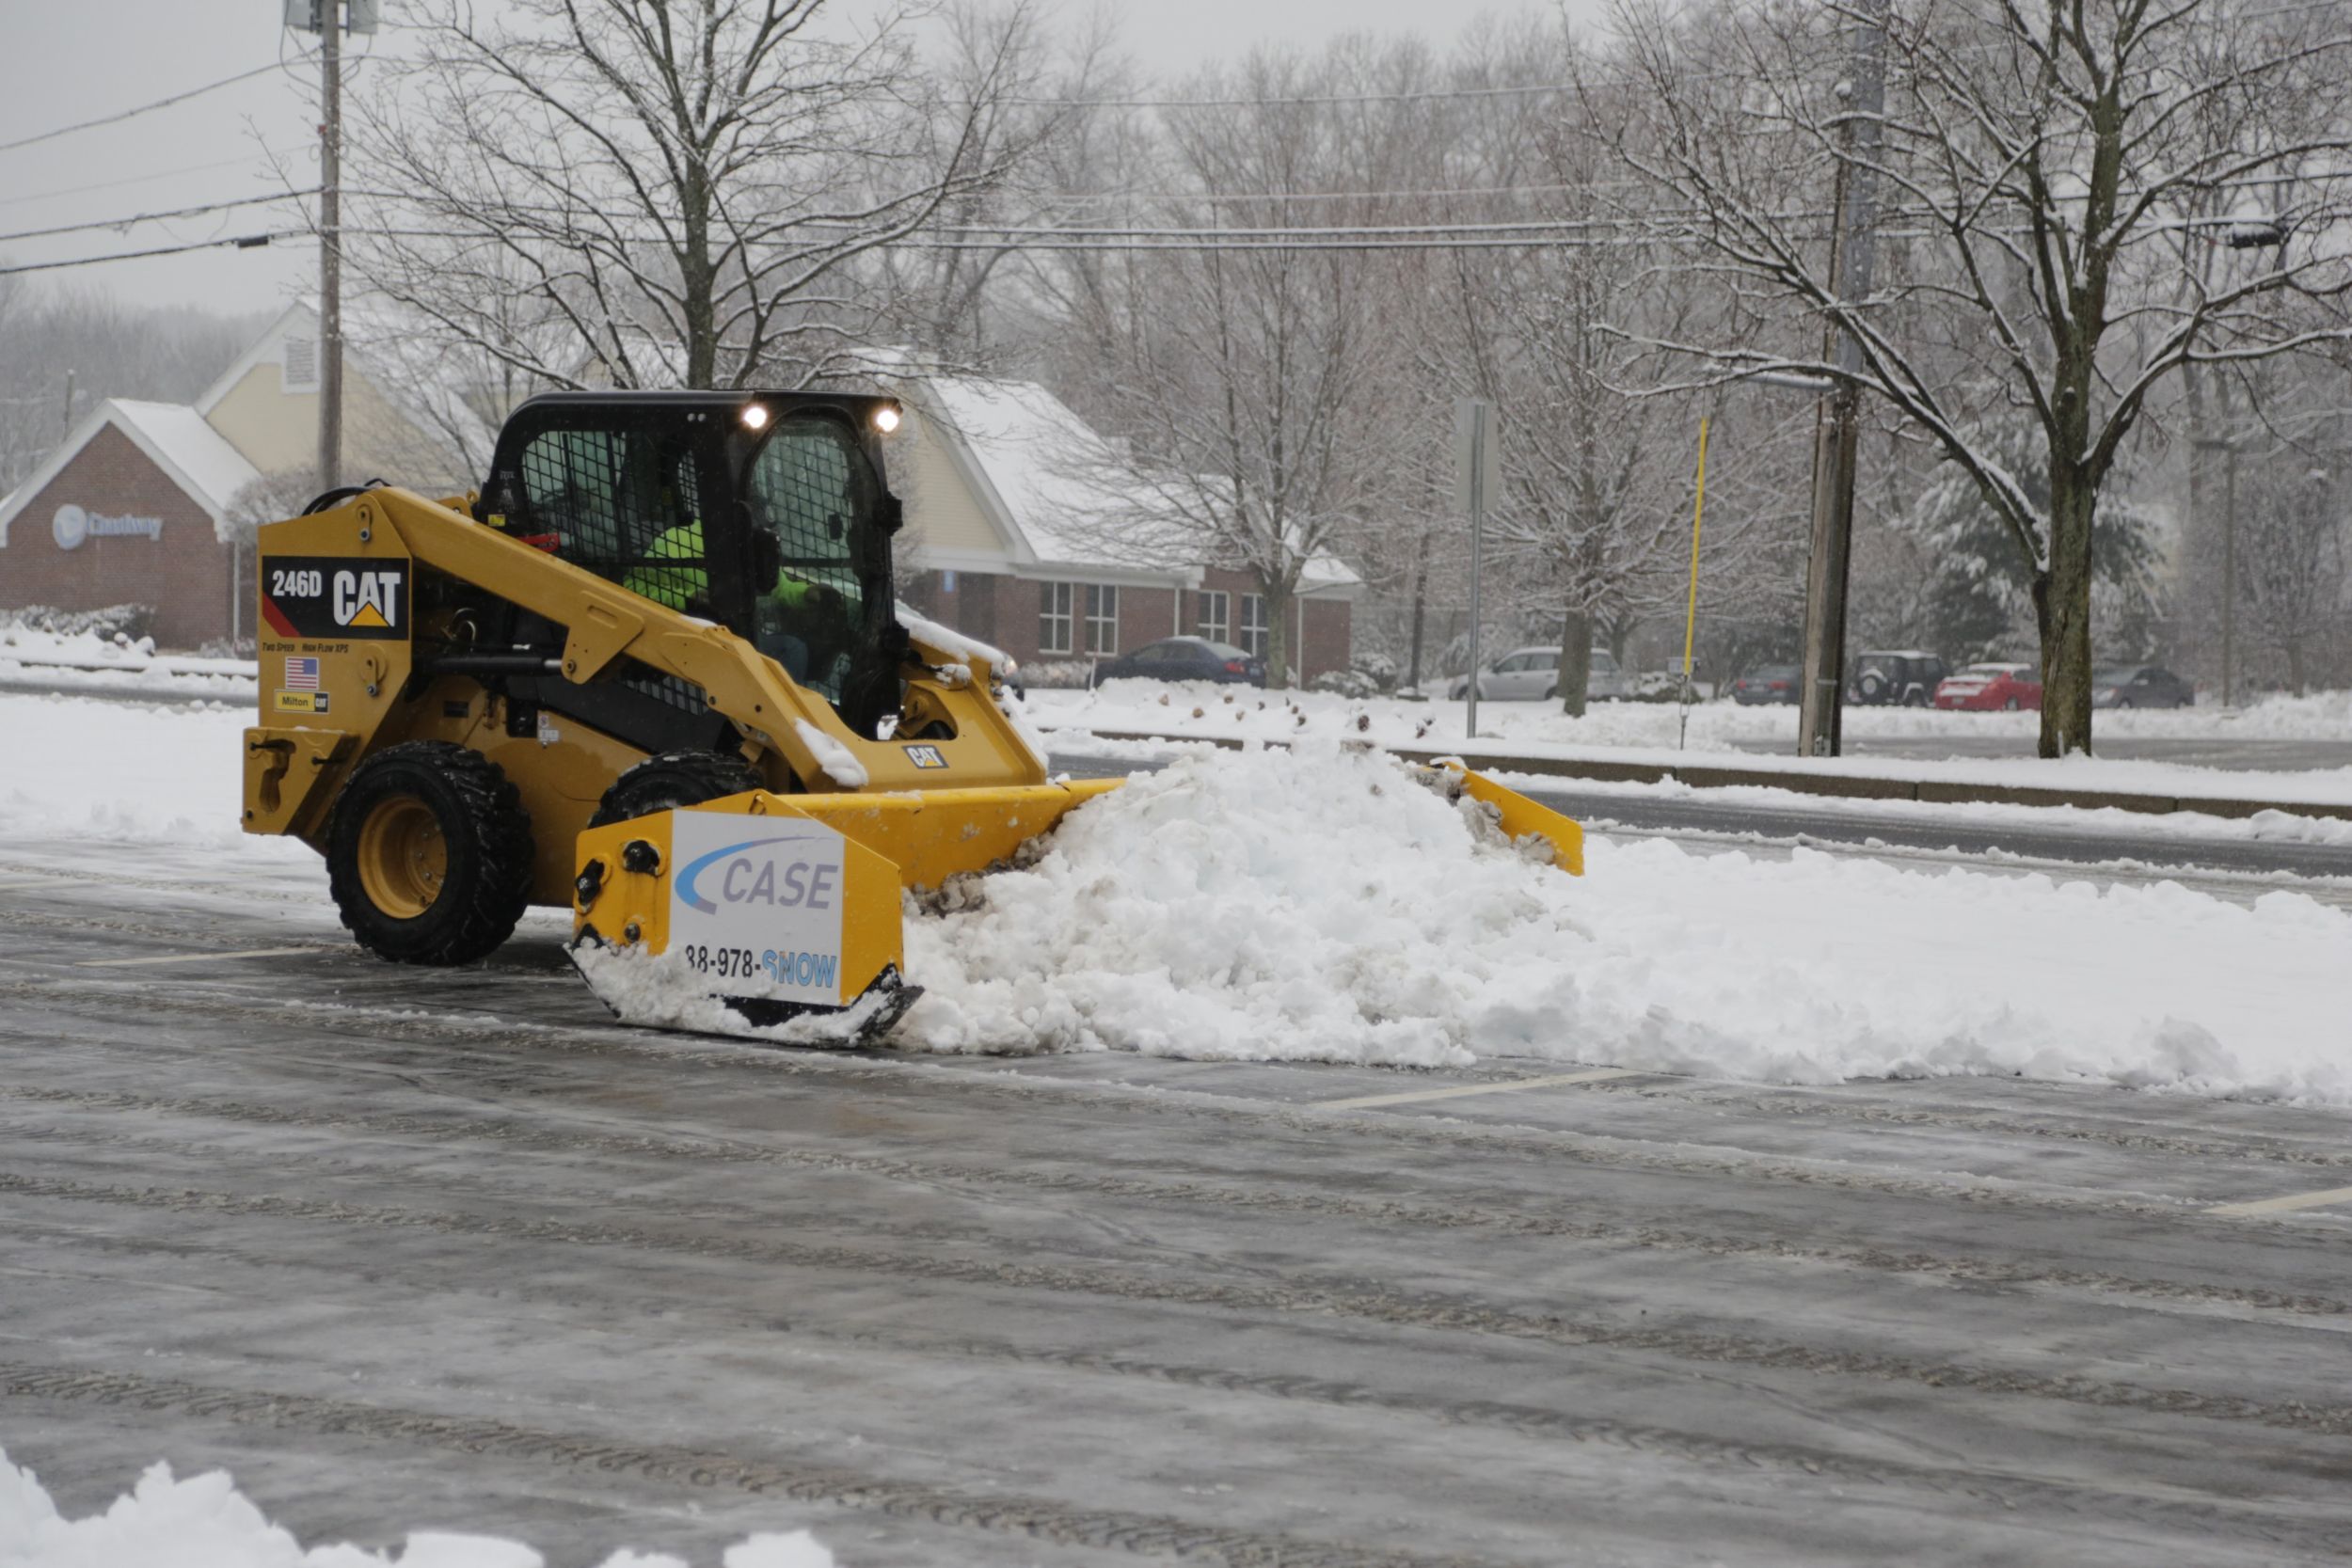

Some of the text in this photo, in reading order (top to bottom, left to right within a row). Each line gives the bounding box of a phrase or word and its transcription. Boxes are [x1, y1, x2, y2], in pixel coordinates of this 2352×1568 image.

[272, 569, 323, 597] 246D
[333, 570, 401, 627] CAT
[282, 696, 326, 708] Milton CAT
[905, 747, 944, 768] CAT
[723, 858, 838, 910] CASE
